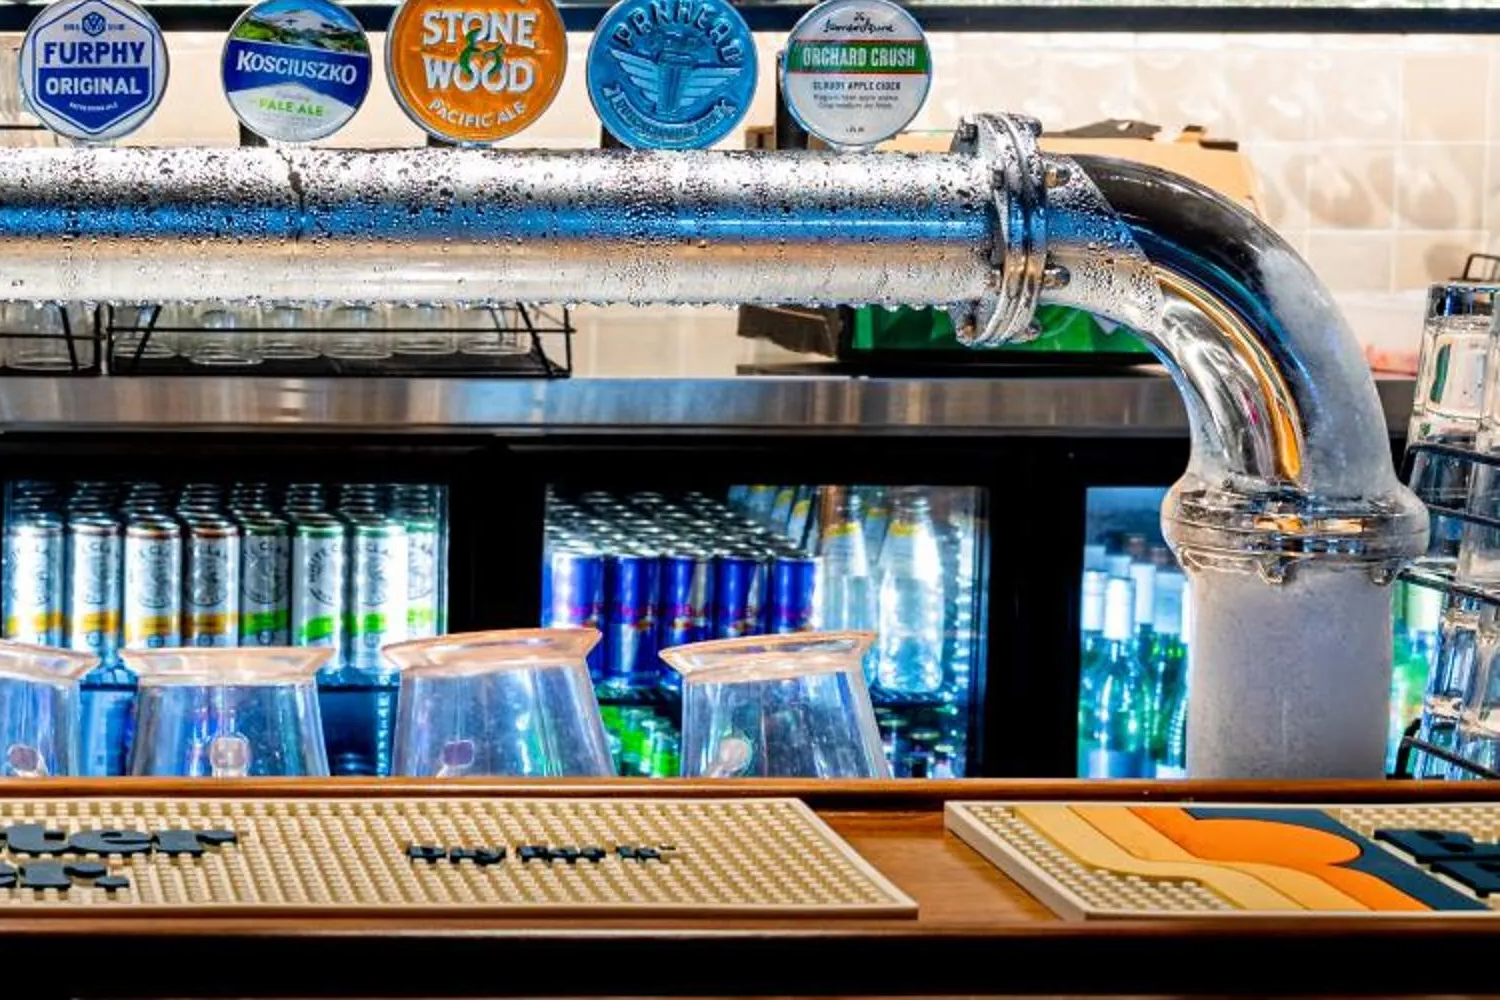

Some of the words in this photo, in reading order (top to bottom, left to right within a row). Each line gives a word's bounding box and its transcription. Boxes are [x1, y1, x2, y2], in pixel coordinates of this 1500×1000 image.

[422, 8, 538, 49] STONE
[43, 41, 146, 65] FURPHY
[803, 47, 867, 67] ORCHARD
[870, 47, 916, 67] CRUSH
[235, 49, 358, 86] KOSCIUSZKO
[422, 54, 534, 94] WOOD
[44, 77, 143, 96] ORIGINAL
[847, 81, 875, 91] APPLE
[875, 81, 901, 91] CIDER
[259, 98, 293, 114] PALE
[295, 105, 325, 117] ALE
[429, 96, 494, 129] PACIFIC
[497, 100, 527, 125] ALE
